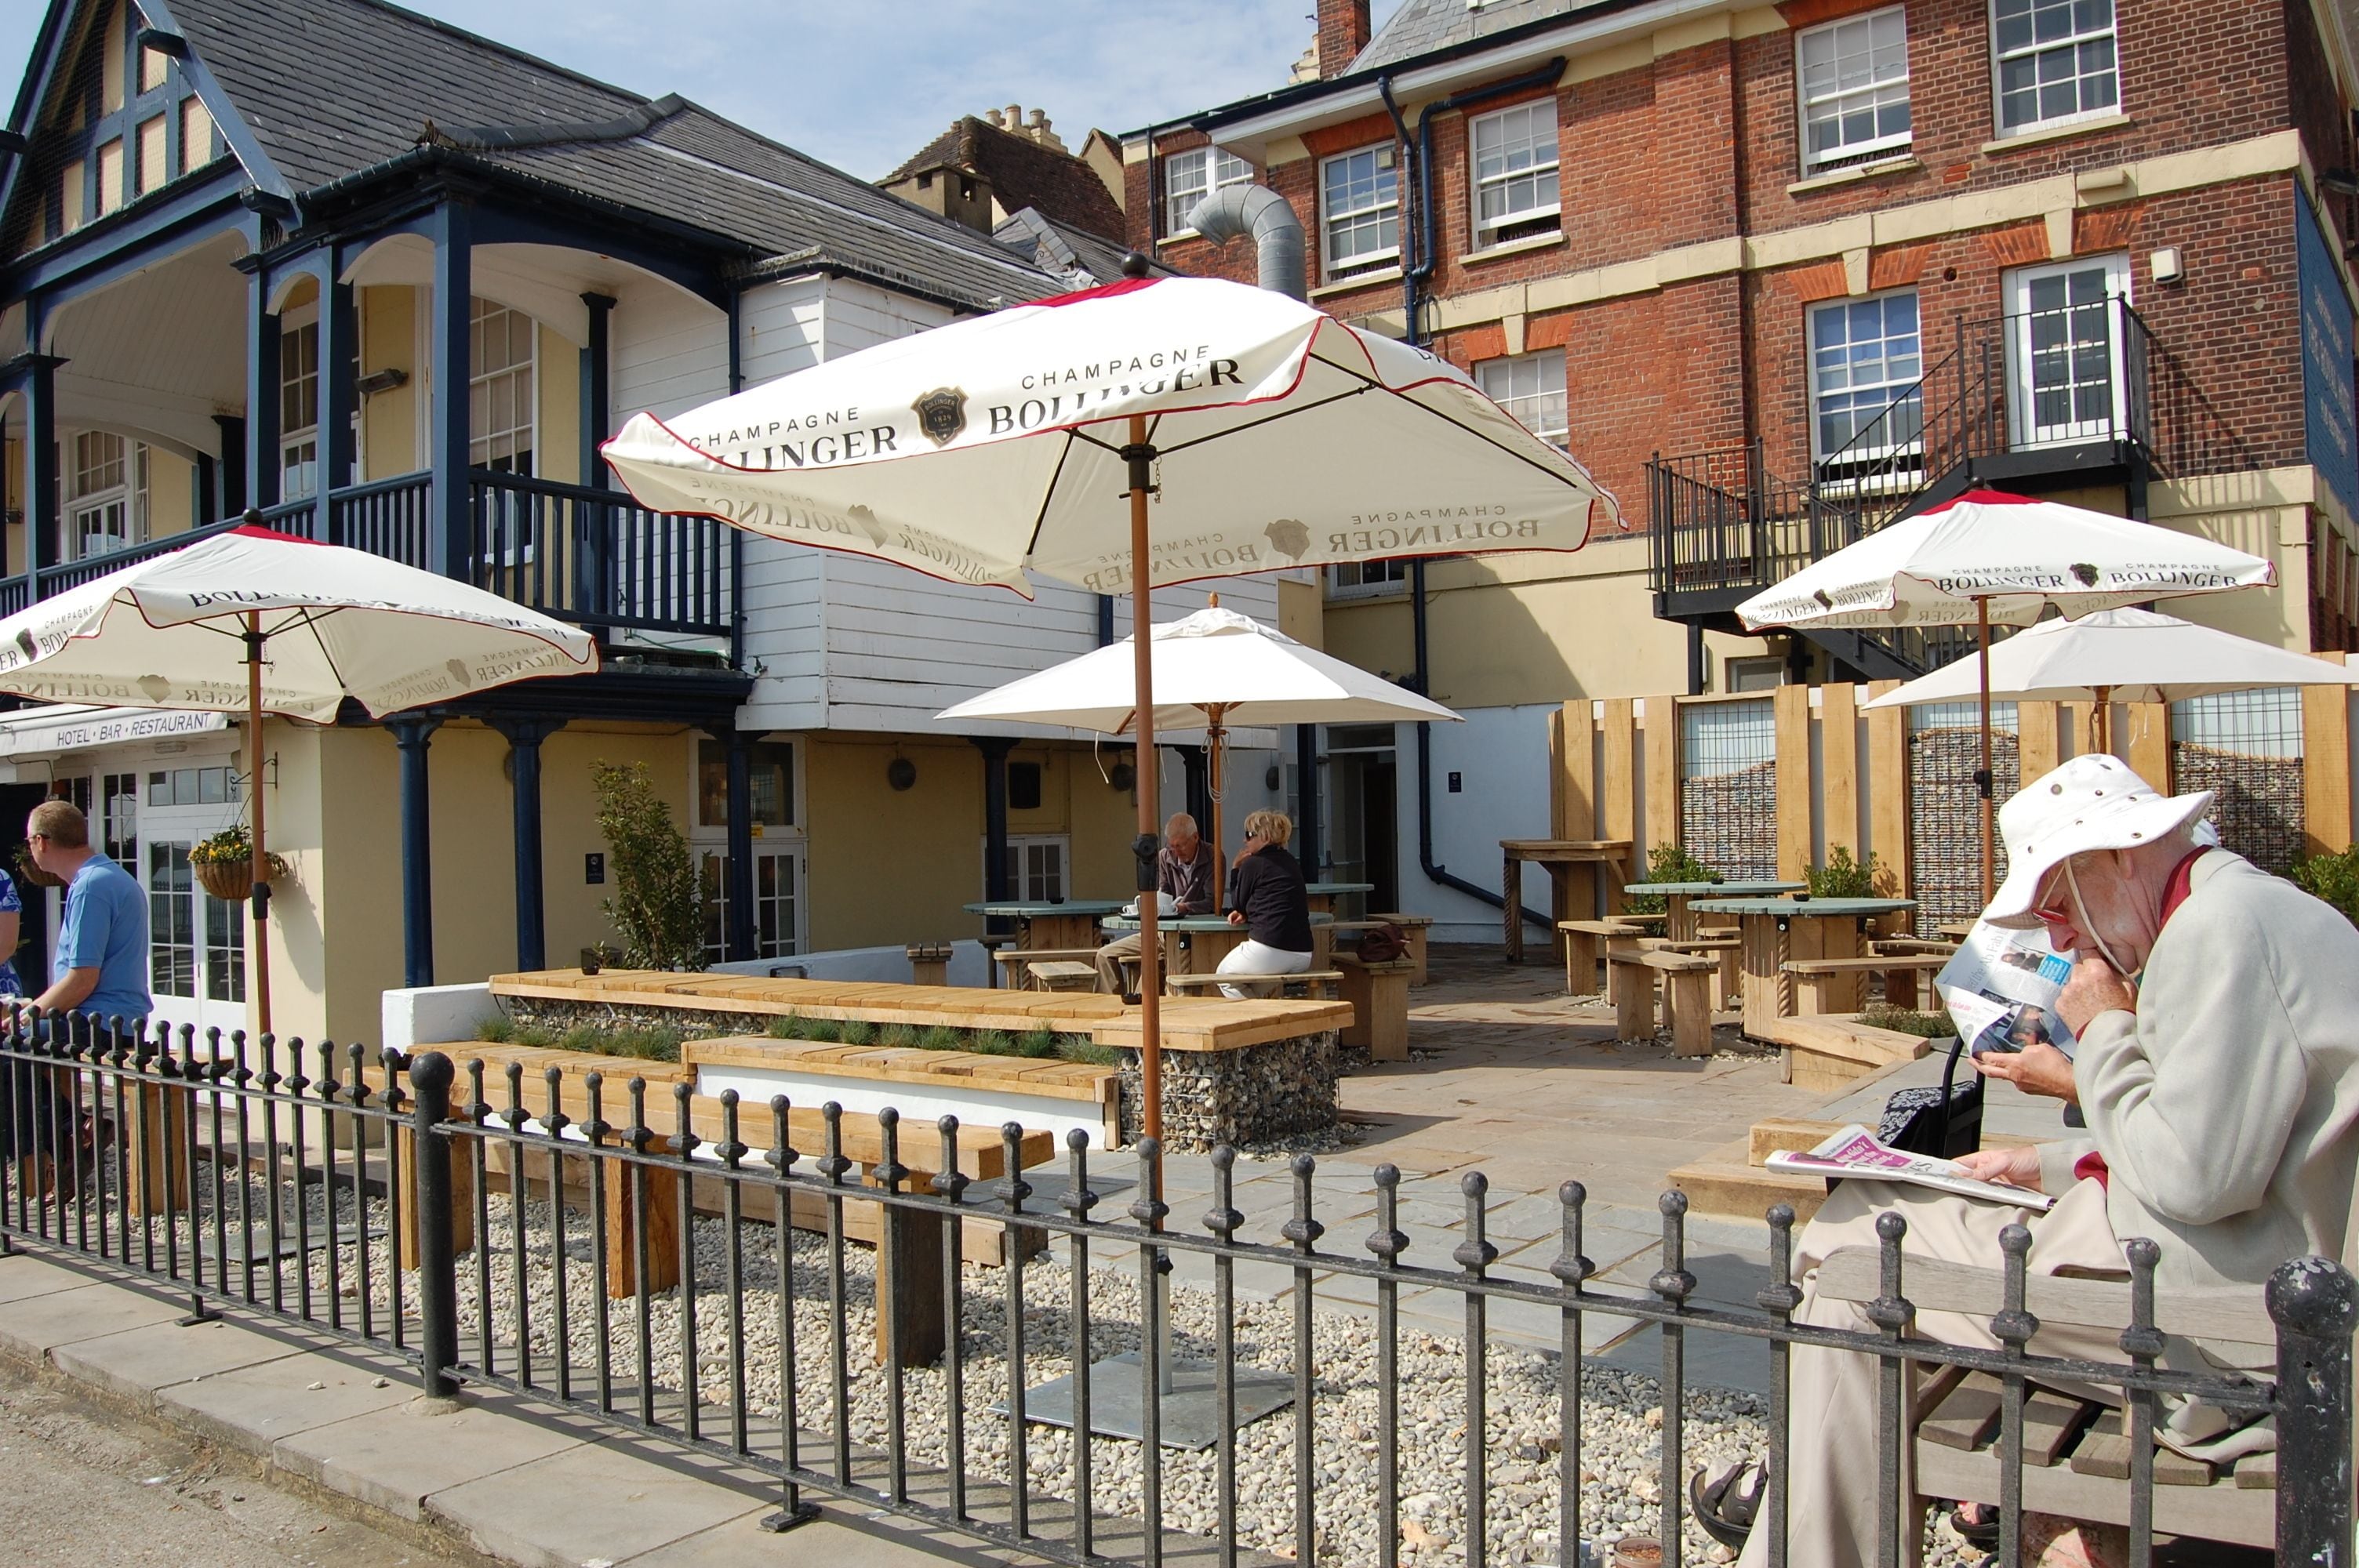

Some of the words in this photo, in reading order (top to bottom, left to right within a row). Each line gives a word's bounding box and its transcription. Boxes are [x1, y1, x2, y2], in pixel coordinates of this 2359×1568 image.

[1022, 346, 1209, 390] CHAMPAGNE
[689, 407, 858, 449] CHAMPAGNE
[1953, 565, 2043, 575] CHAMPAGNE
[58, 729, 90, 746] HOTEL
[100, 724, 122, 741] BAR
[131, 713, 211, 736] RESTAURANT
